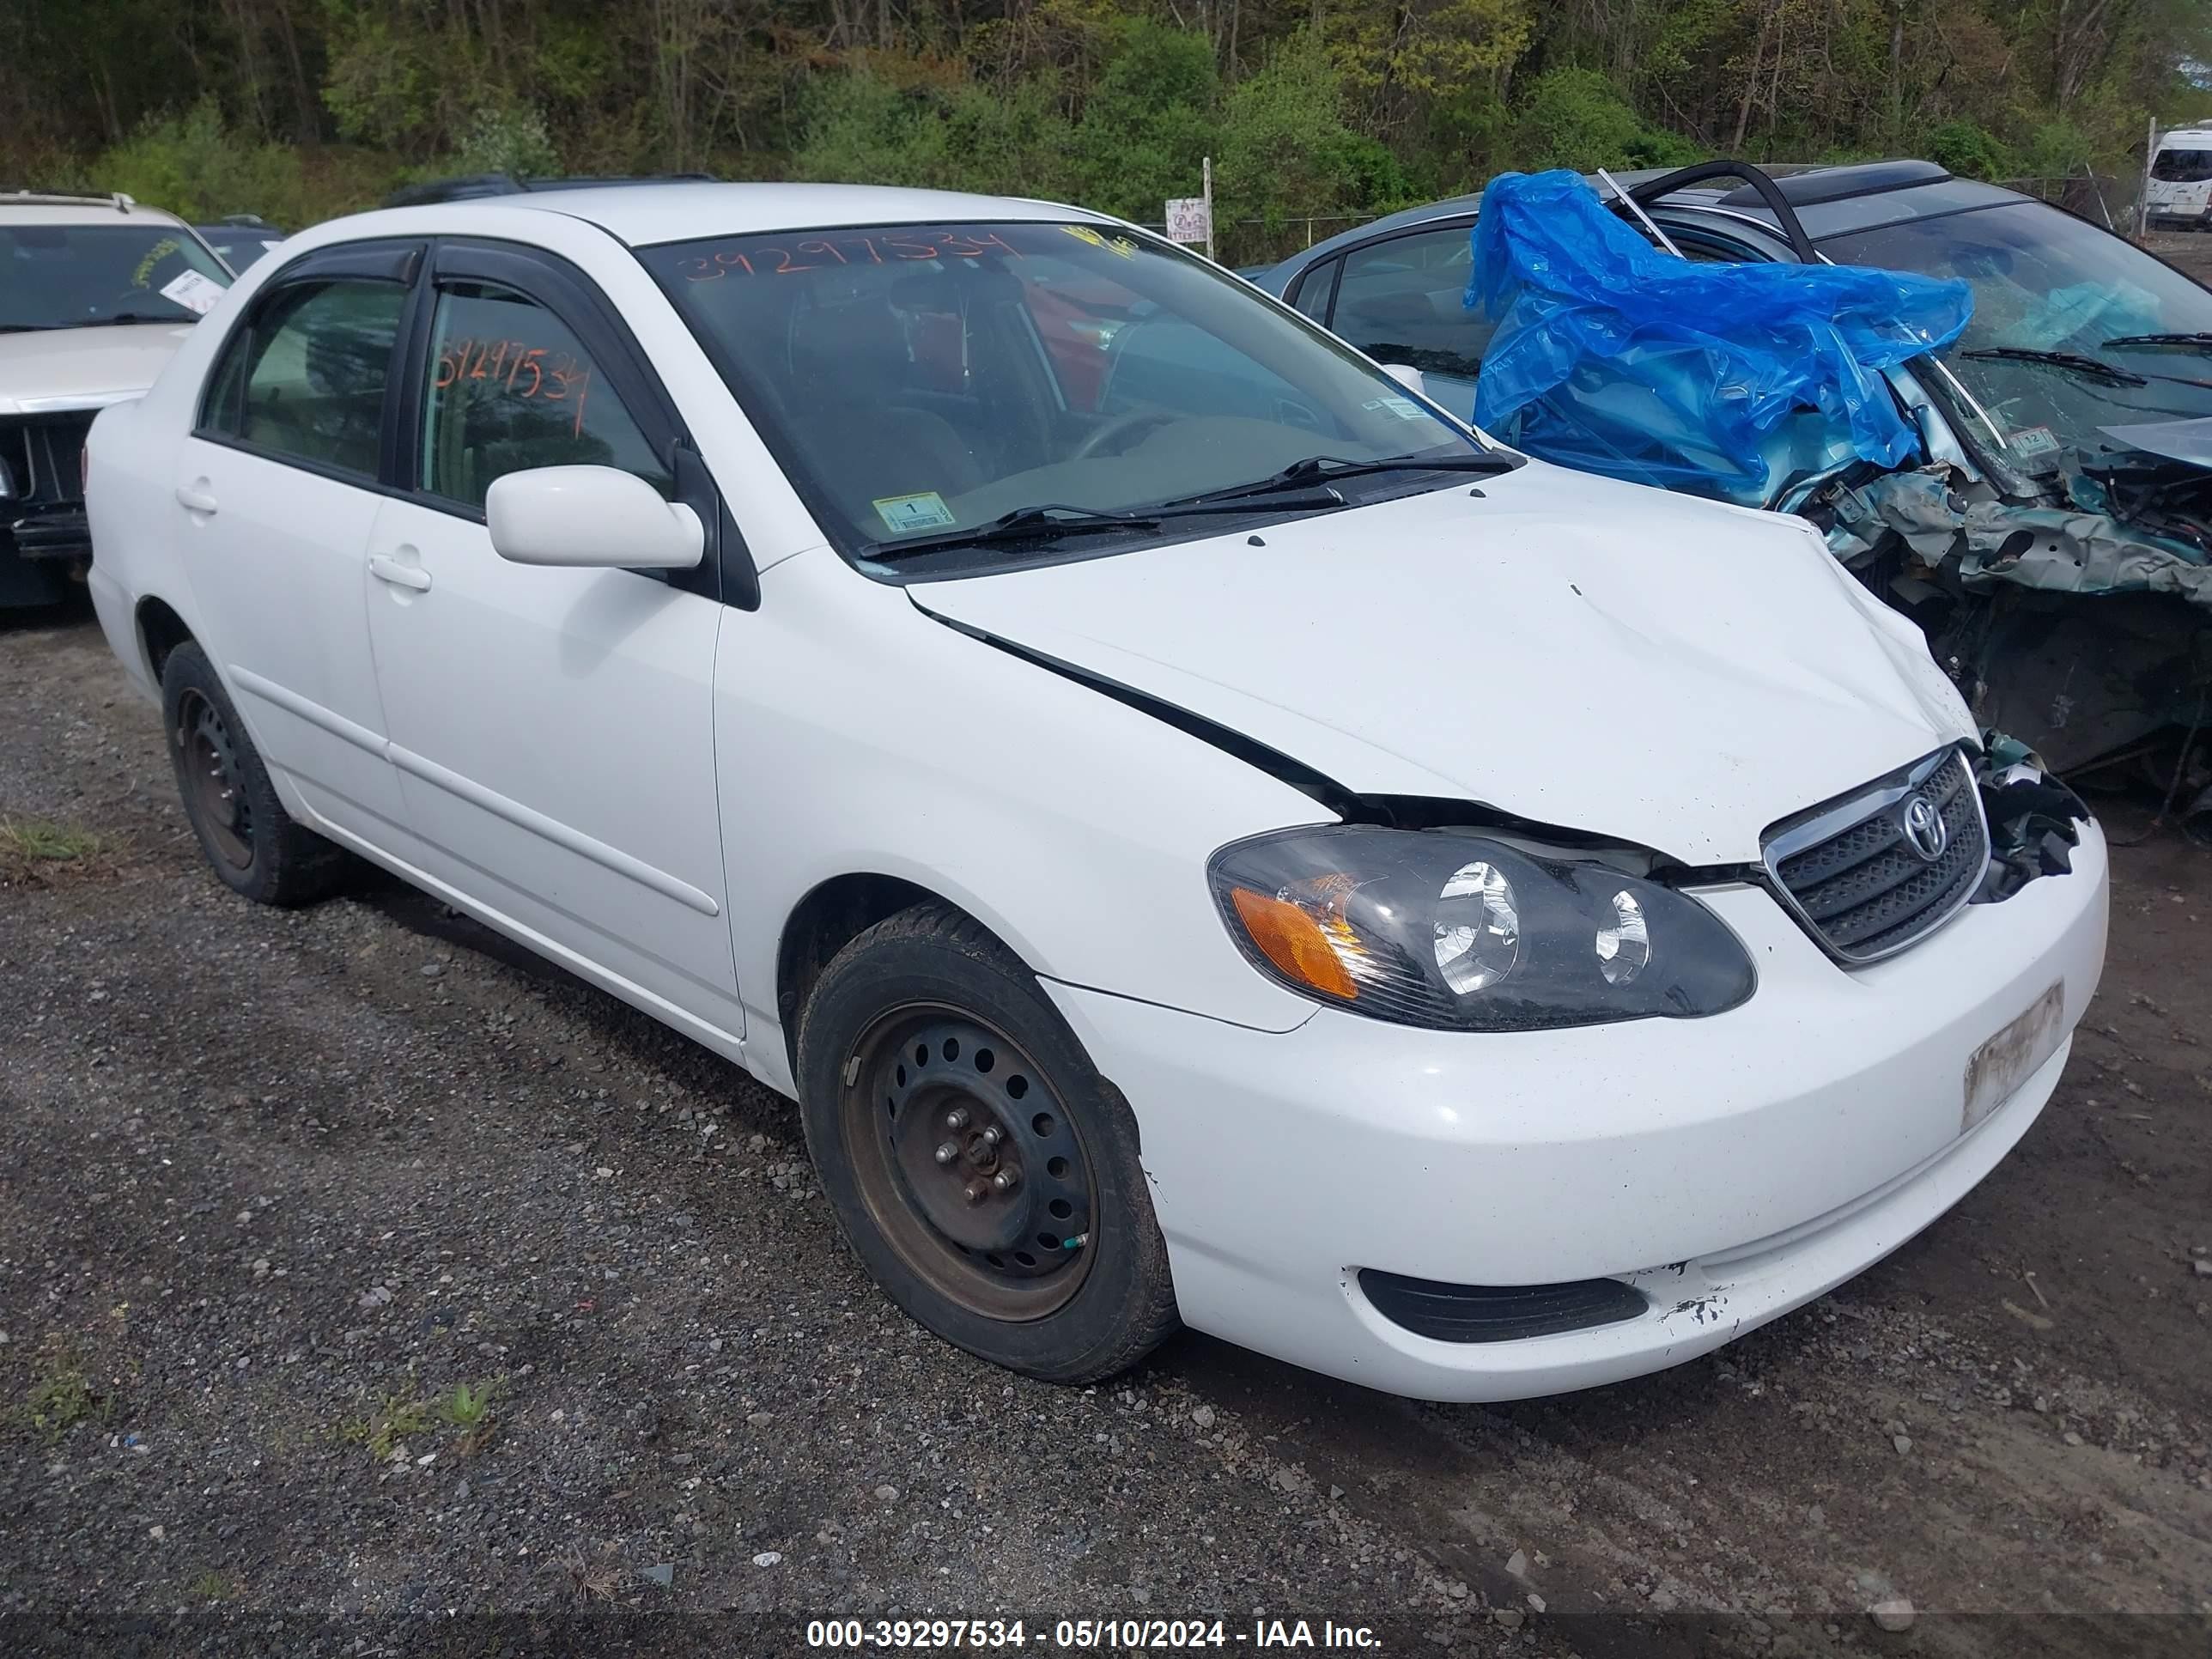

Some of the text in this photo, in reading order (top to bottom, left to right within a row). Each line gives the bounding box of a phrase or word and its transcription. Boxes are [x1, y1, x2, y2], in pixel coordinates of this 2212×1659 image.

[677, 232, 1024, 282] 39297534
[2025, 434, 2040, 444] 12
[906, 503, 917, 514] 1
